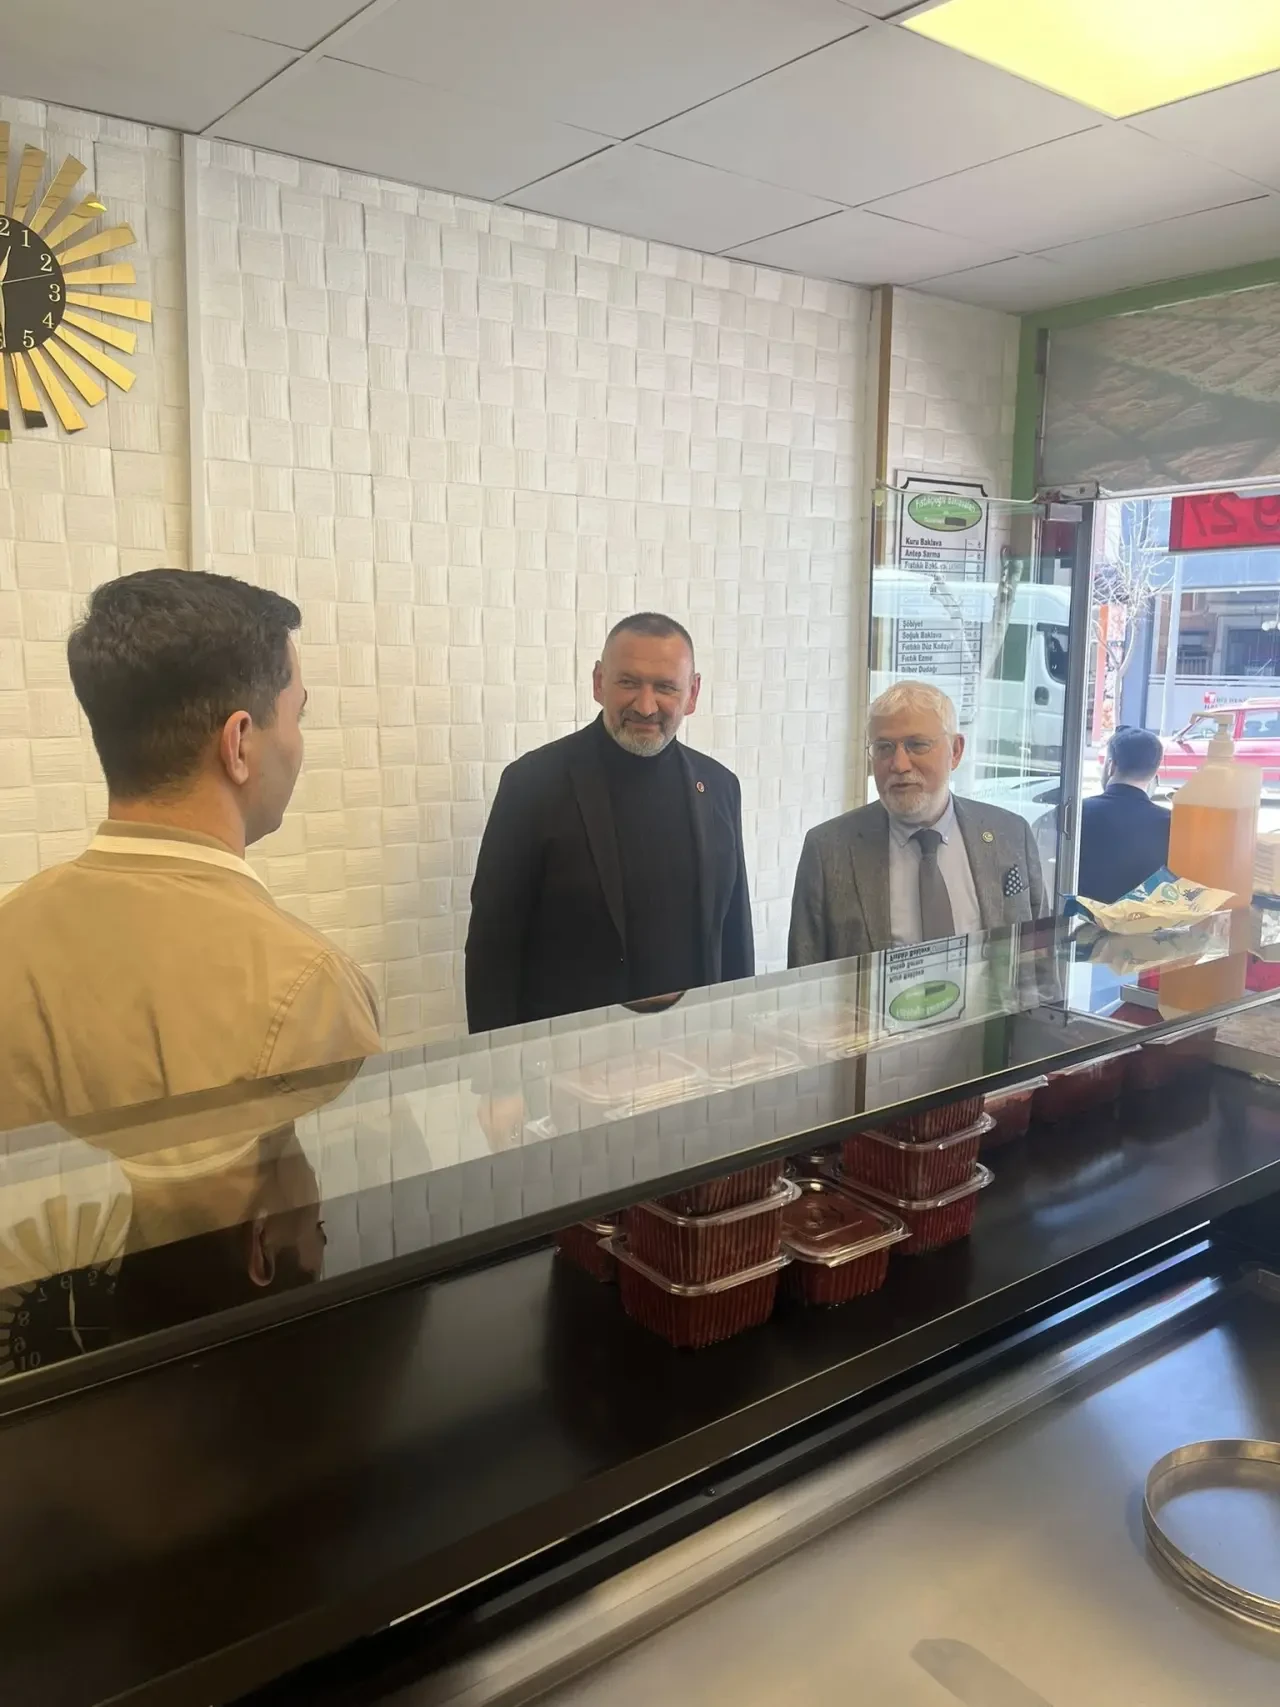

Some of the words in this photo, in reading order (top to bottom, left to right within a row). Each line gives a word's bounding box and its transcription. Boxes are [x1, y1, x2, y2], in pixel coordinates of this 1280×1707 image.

[0, 218, 10, 236] 2
[21, 229, 31, 247] 1
[40, 254, 52, 272] 2
[49, 284, 61, 302] 3
[42, 311, 54, 329] 4
[23, 329, 35, 348] 5
[905, 537, 919, 546] Kuru
[920, 538, 942, 547] Baklava
[905, 549, 922, 559] Antep
[922, 550, 941, 558] Sarma
